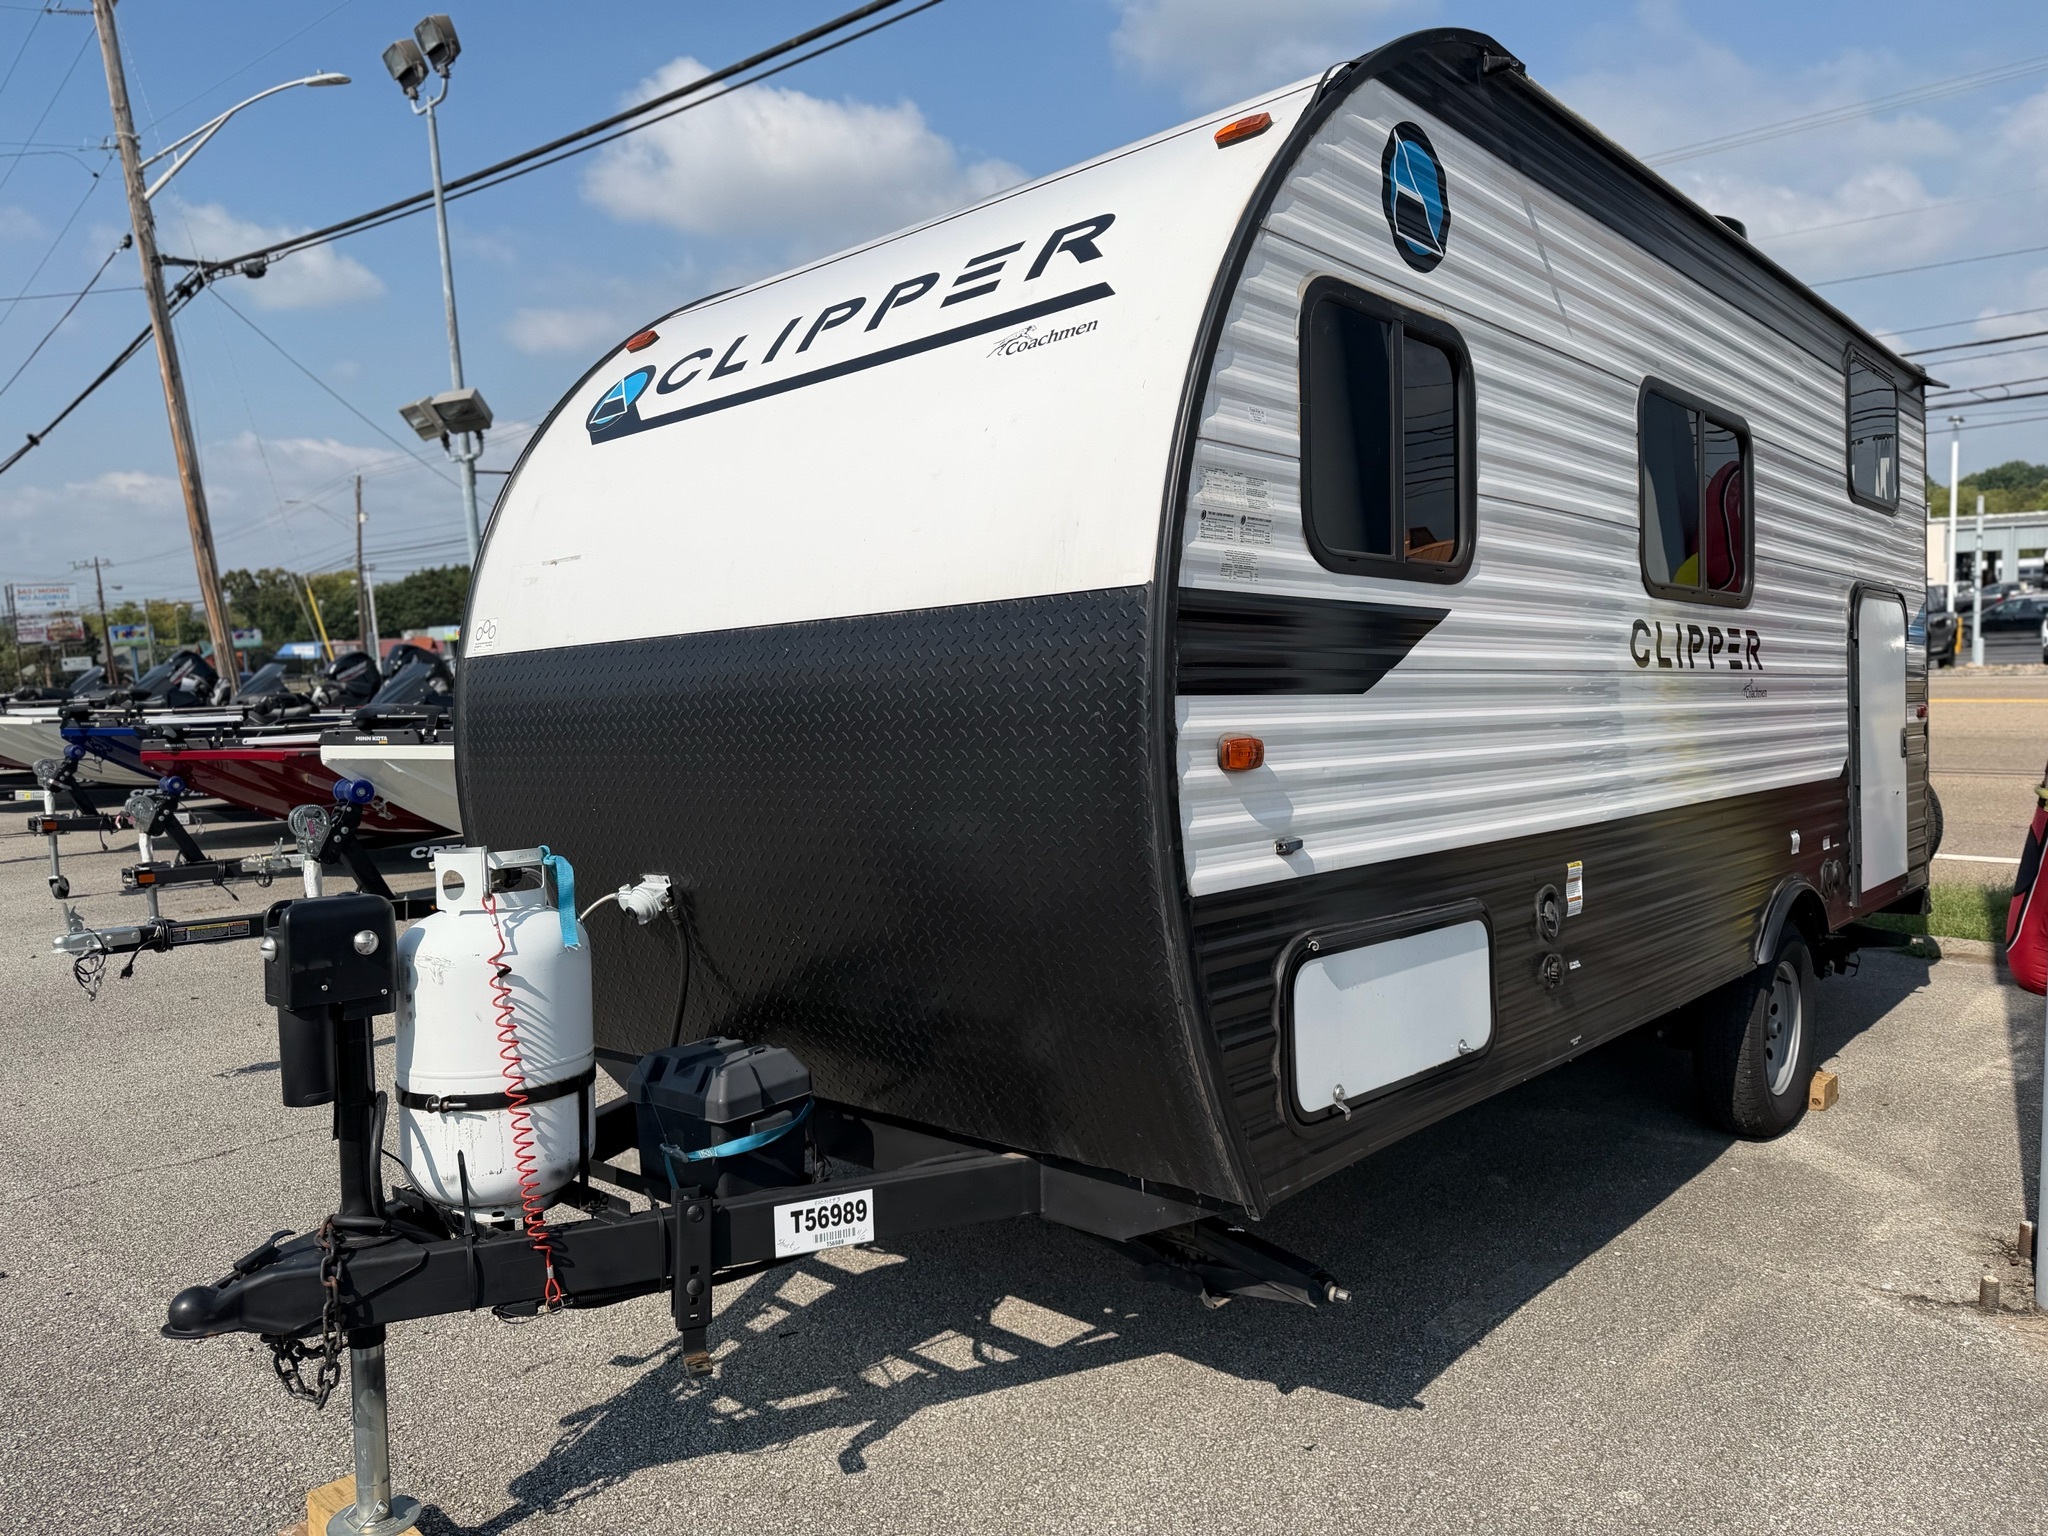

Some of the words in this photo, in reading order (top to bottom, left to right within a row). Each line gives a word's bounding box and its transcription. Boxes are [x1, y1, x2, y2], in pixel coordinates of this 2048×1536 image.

[657, 213, 1117, 396] CLIPPER
[1005, 319, 1099, 356] Coachmen
[1630, 618, 1764, 670] CLIPPER
[790, 1198, 868, 1234] T56989
